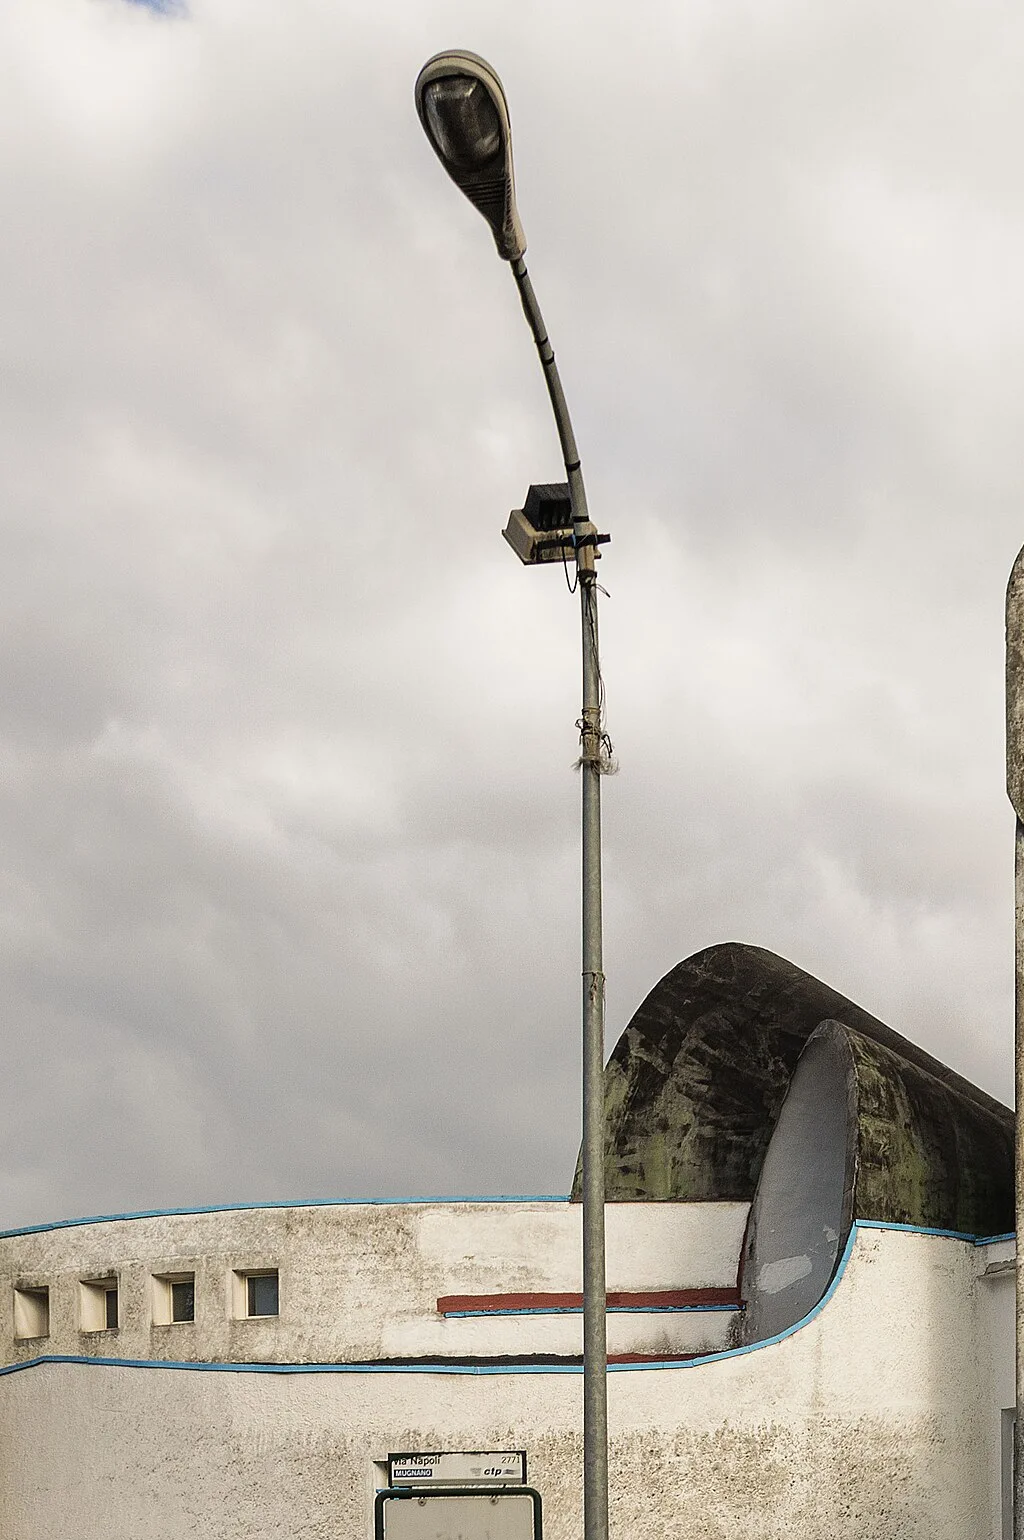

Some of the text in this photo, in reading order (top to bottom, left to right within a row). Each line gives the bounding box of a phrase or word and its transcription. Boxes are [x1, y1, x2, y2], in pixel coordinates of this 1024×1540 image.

[410, 1456, 440, 1466] Napoli
[501, 1456, 520, 1464] 2771
[395, 1469, 431, 1477] MUGNANO
